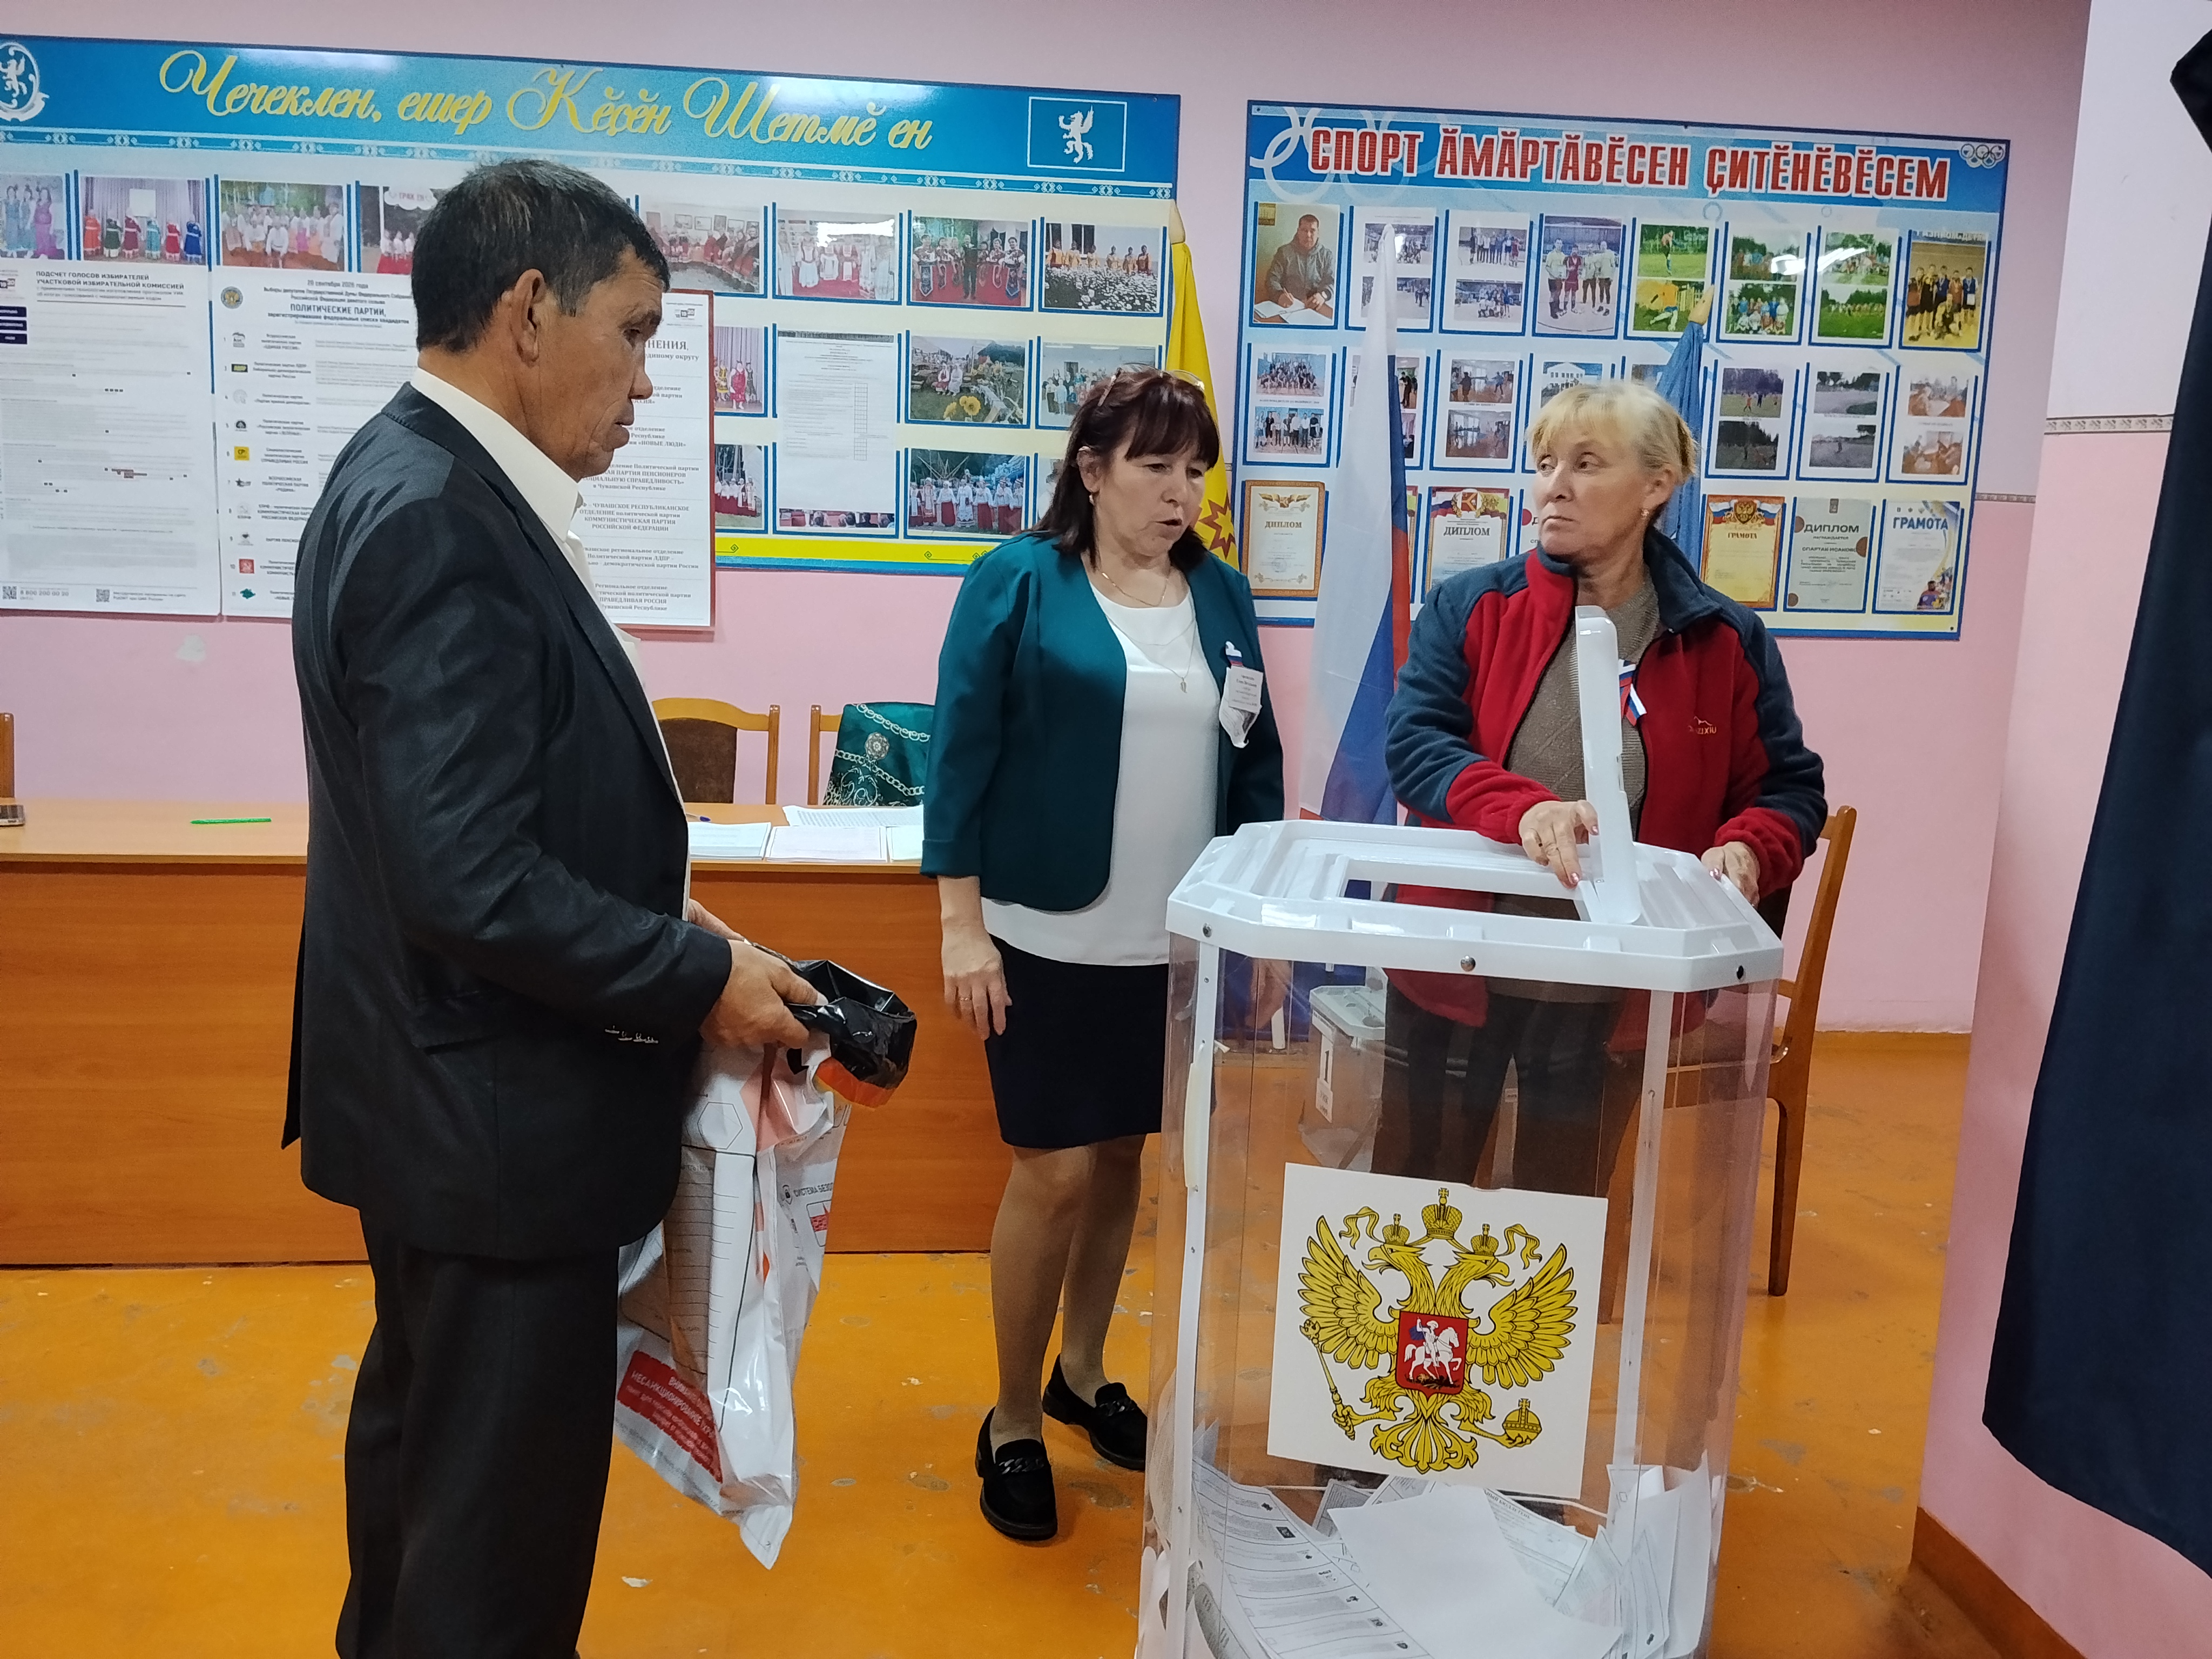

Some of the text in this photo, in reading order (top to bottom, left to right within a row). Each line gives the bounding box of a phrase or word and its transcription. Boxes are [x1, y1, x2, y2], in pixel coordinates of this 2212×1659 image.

[397, 91, 493, 135] ешер
[683, 77, 887, 146] Шетмӗ
[888, 118, 933, 150] ен
[1312, 127, 1948, 199] СПОРТ ӐМӐРТӐВӖСЕН ҪИТӖНӖВӖСЕМ
[83, 280, 140, 288] ИЗБИРАТЕЛЬНОЙ
[291, 304, 386, 317] ПОЛИТИЧЕСКИЕ ПАРТИИ,
[1804, 524, 1859, 533] ДИПЛОМ
[1892, 516, 1948, 530] ГРАМОТА
[1444, 527, 1491, 536] ДИПЛОМ
